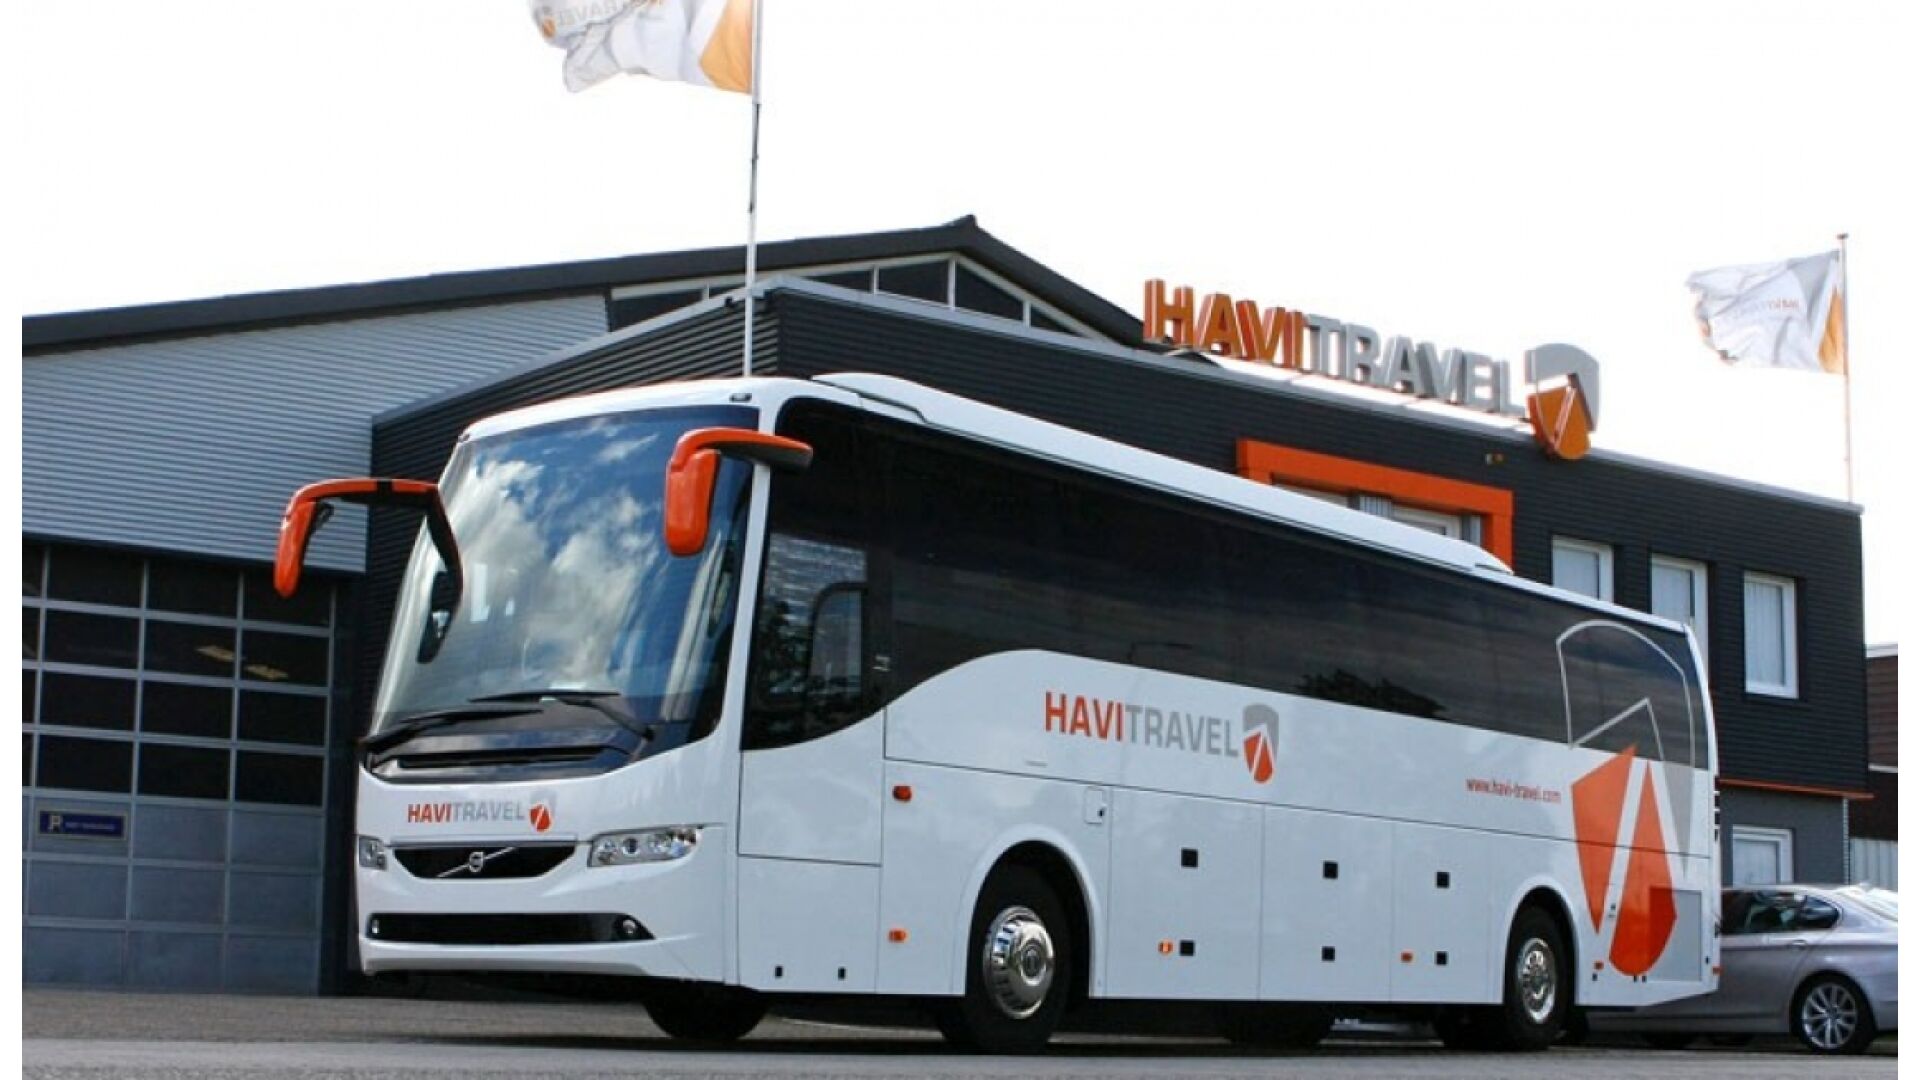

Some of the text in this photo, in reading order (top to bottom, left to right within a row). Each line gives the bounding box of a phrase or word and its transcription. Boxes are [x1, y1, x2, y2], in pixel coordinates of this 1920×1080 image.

[1144, 278, 1527, 417] HAVITRAVEL
[1044, 690, 1240, 758] HAVITRAVEL
[407, 801, 526, 824] HAVITRAVEL
